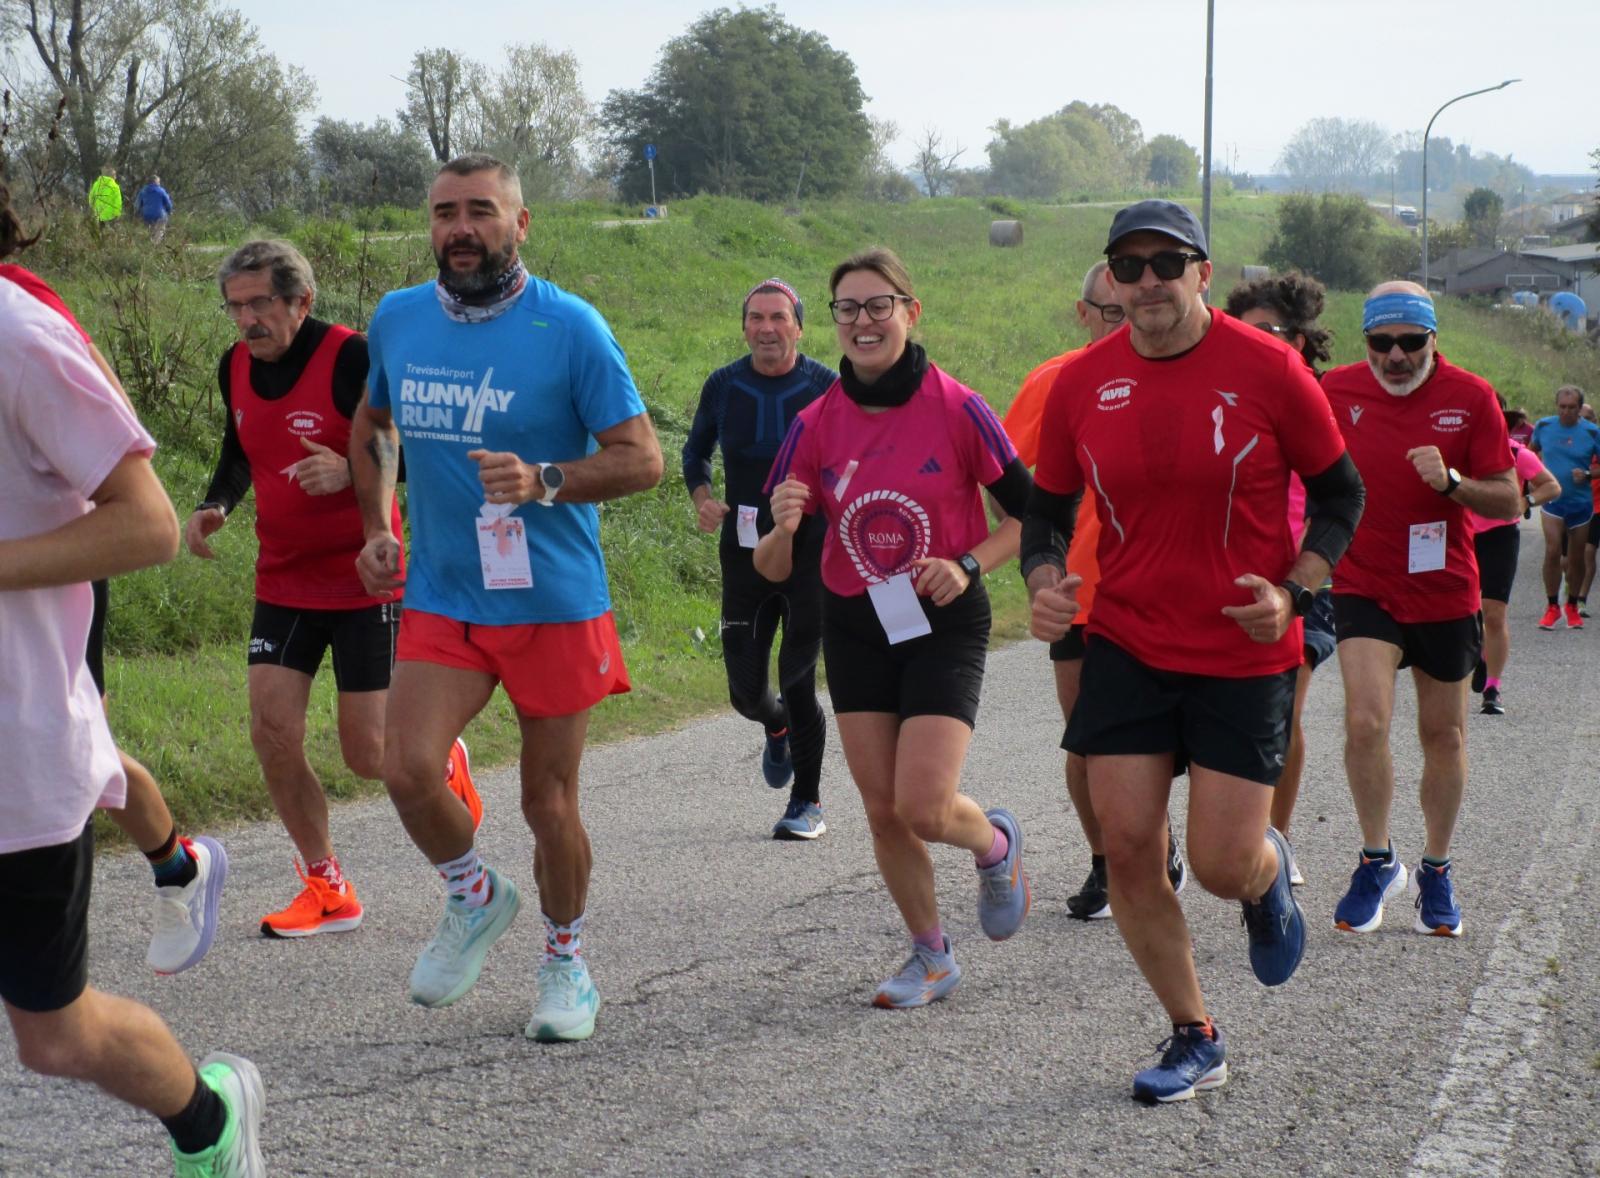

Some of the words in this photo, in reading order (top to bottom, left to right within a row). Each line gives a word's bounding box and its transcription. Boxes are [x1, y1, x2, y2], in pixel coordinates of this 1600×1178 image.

[406, 363, 474, 380] TrevisoAirport
[400, 373, 515, 420] RUNWAY
[1100, 385, 1130, 401] AVIS
[401, 404, 453, 430] RUN
[1439, 416, 1463, 425] AVIS
[868, 532, 905, 545] ROMA
